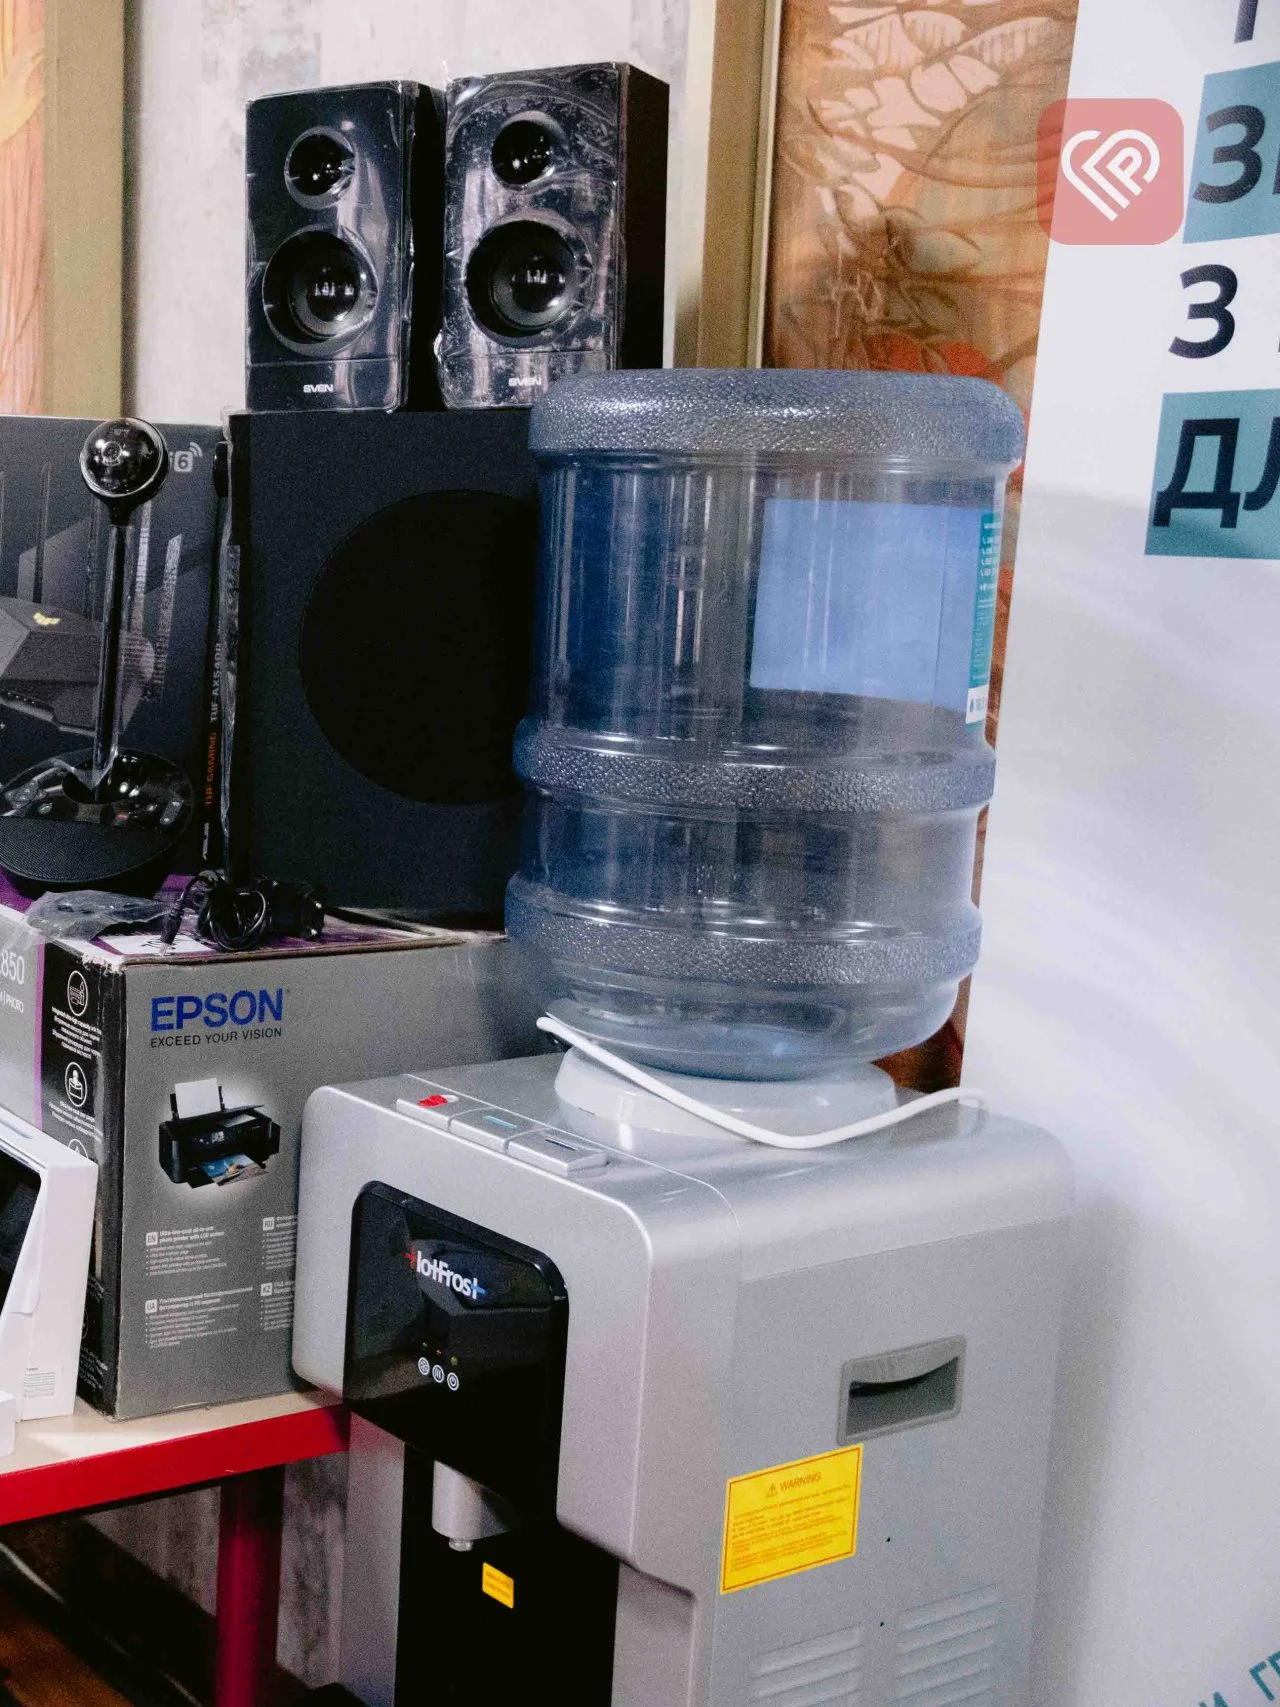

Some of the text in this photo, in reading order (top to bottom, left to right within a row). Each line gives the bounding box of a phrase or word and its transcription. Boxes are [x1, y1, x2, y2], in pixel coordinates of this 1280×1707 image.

[1193, 104, 1280, 204] З
[303, 383, 333, 393] SVEN
[509, 376, 542, 387] SVEN
[151, 988, 283, 1031] EPSON
[150, 1027, 282, 1048] EXCEED YOUR VISION
[780, 1472, 822, 1490] WARNING
